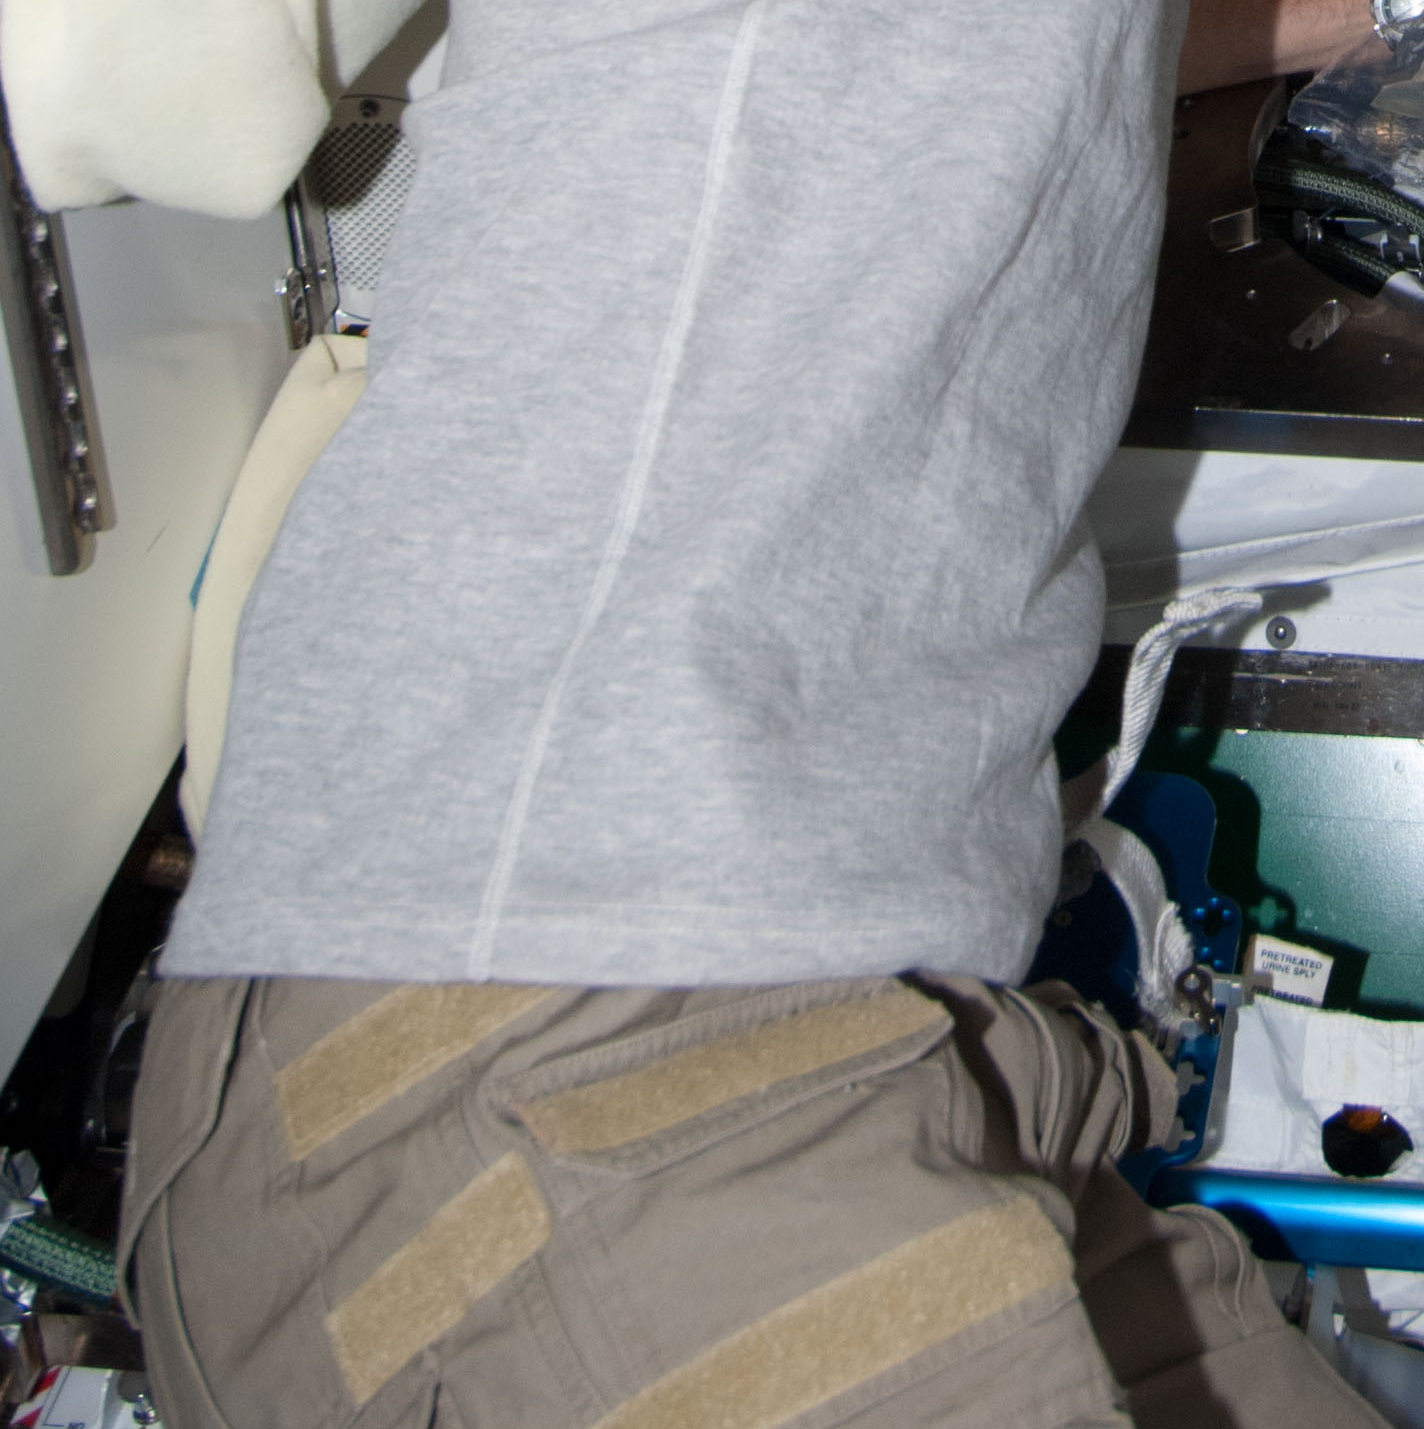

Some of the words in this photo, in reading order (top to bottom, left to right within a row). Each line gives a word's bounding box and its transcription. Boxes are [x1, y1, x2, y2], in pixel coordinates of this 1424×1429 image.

[1260, 948, 1323, 970] PRETREATED
[1262, 961, 1290, 974] URINE
[1293, 966, 1317, 979] SPLY
